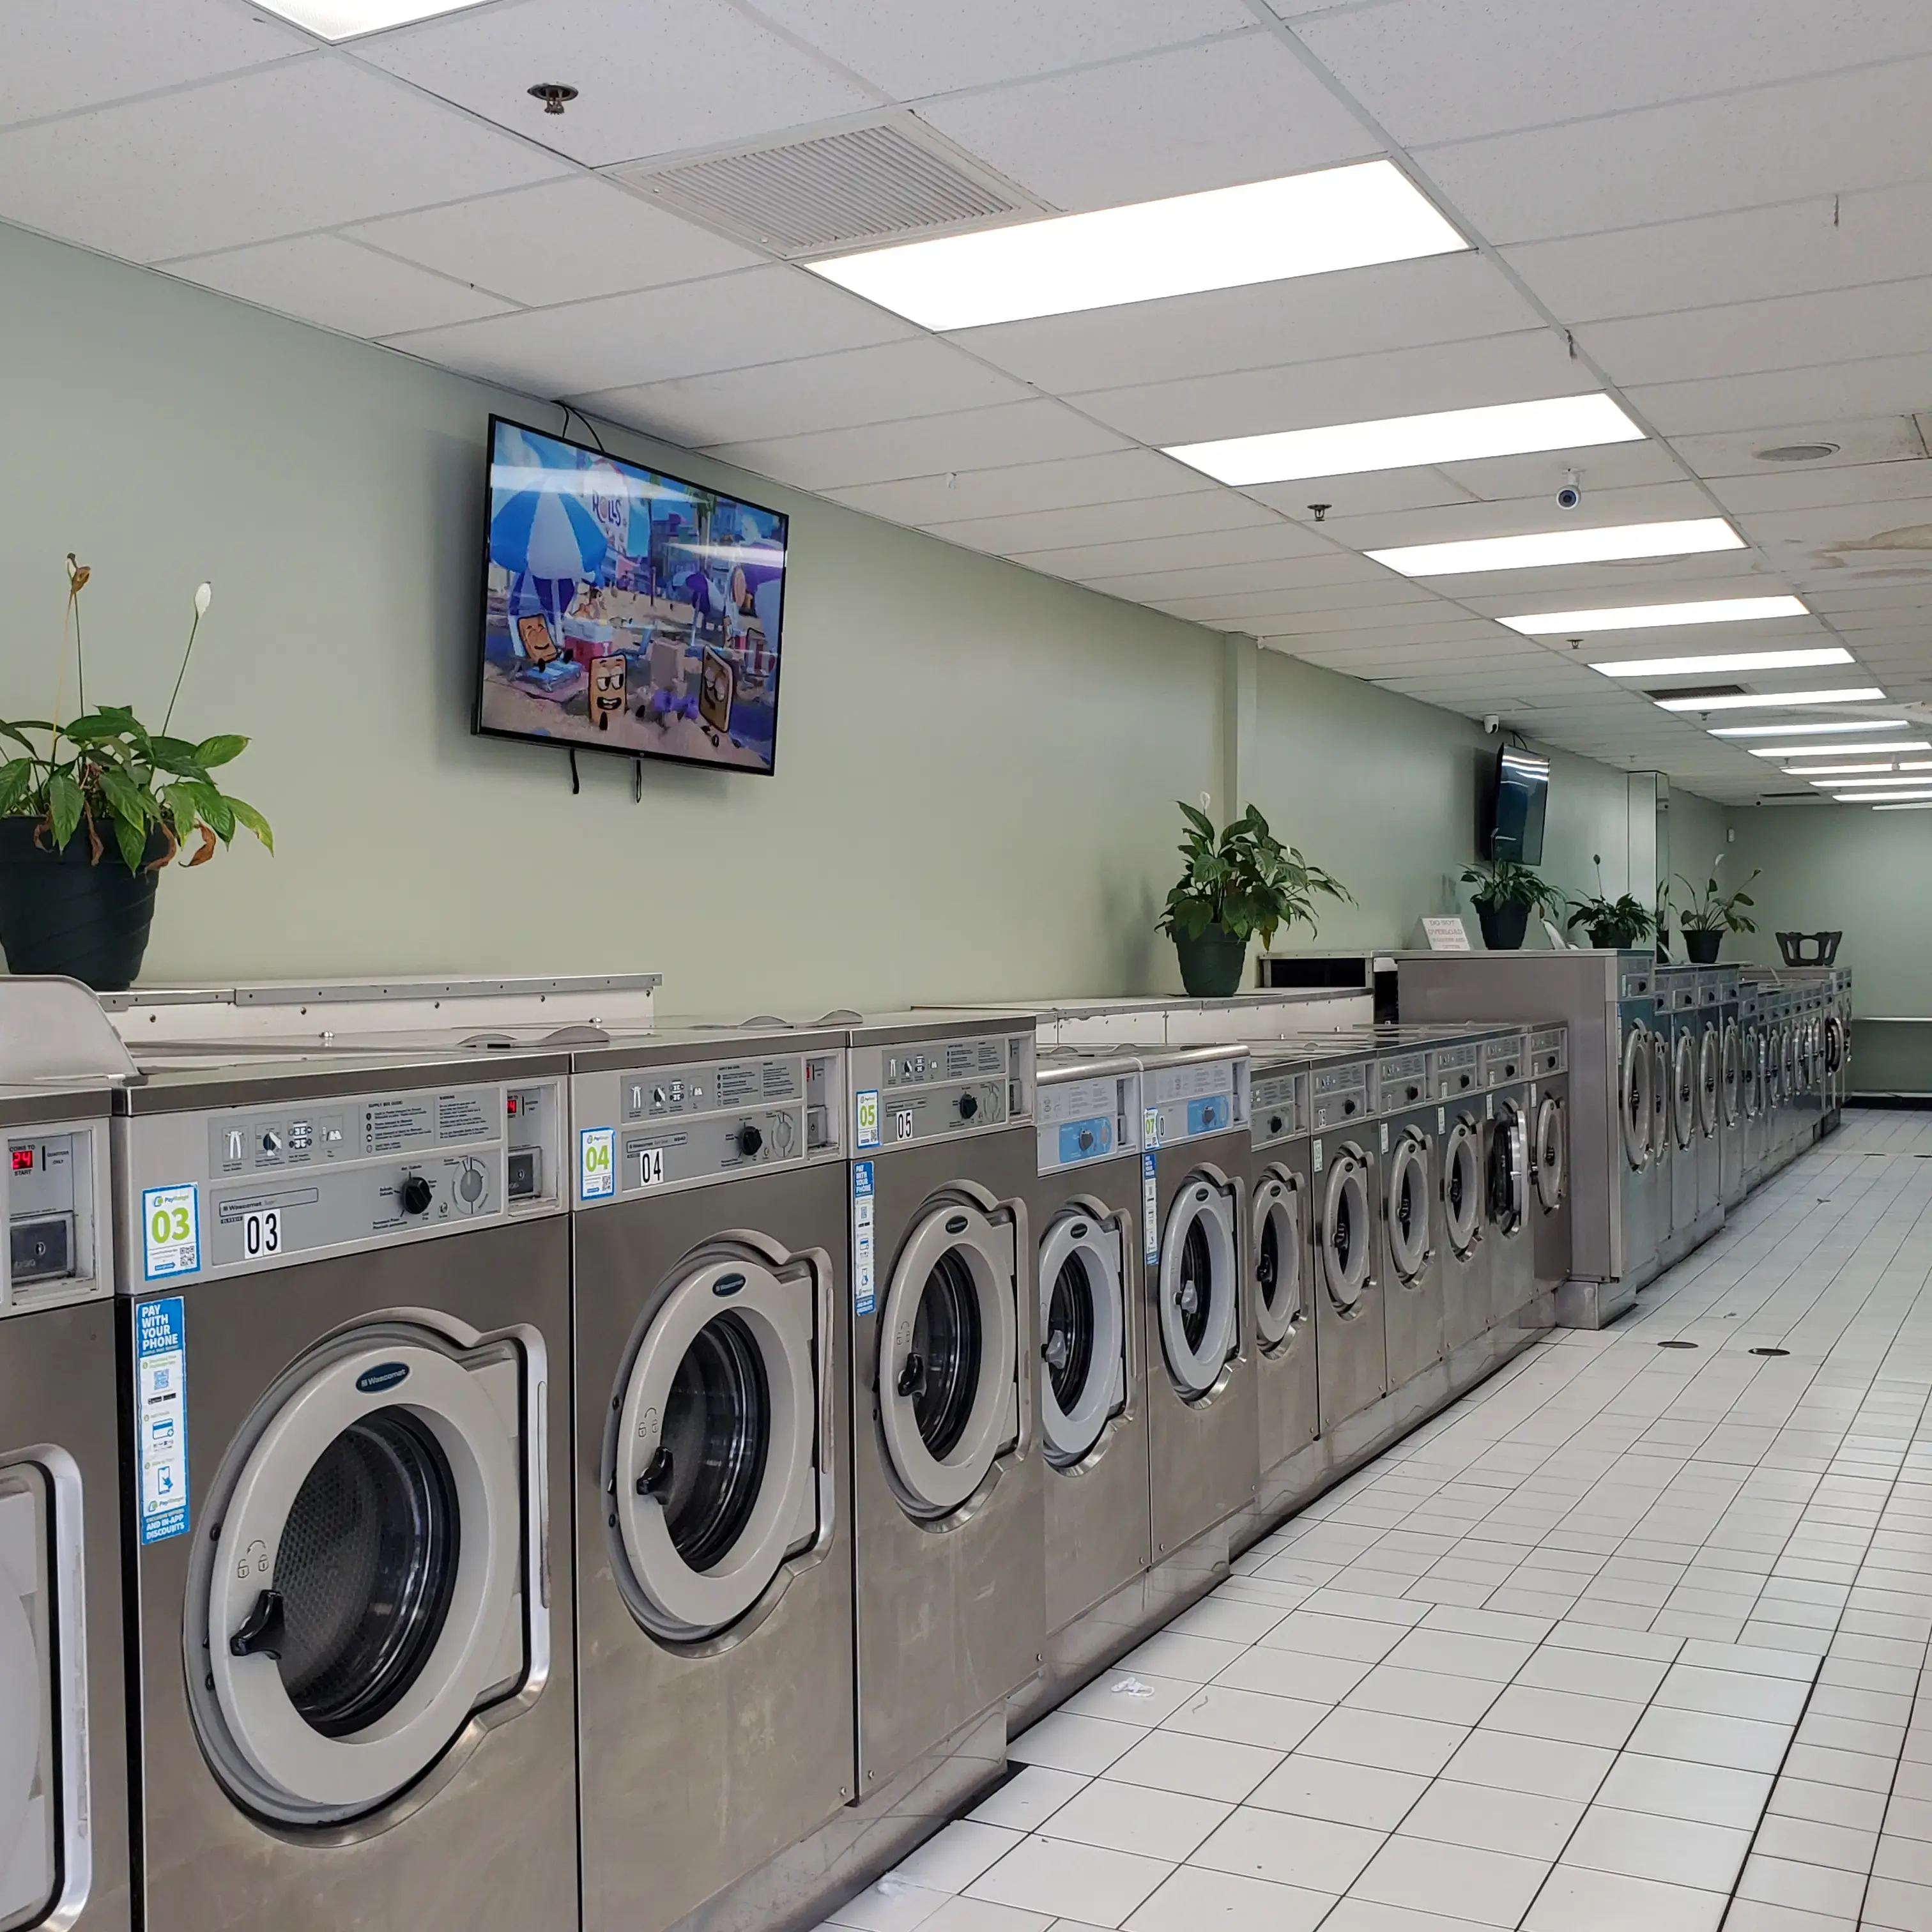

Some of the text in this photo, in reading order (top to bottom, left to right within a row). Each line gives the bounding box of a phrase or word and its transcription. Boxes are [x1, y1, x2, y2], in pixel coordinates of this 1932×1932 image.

[860, 1105, 875, 1126] 05
[898, 1112, 911, 1138] 05
[1146, 1118, 1154, 1135] 07
[12, 1151, 31, 1169] 24
[586, 1145, 610, 1172] 04
[643, 1151, 661, 1183] 04
[229, 1201, 262, 1211] Wascomat
[151, 1207, 190, 1243] 03
[247, 1213, 278, 1254] 03
[142, 1305, 161, 1317] PAY
[141, 1314, 169, 1328] WITH
[142, 1324, 171, 1339] YOUR
[142, 1333, 178, 1350] PHONE
[368, 1368, 406, 1385] Wascomat
[146, 1514, 183, 1531] AND IN-APP
